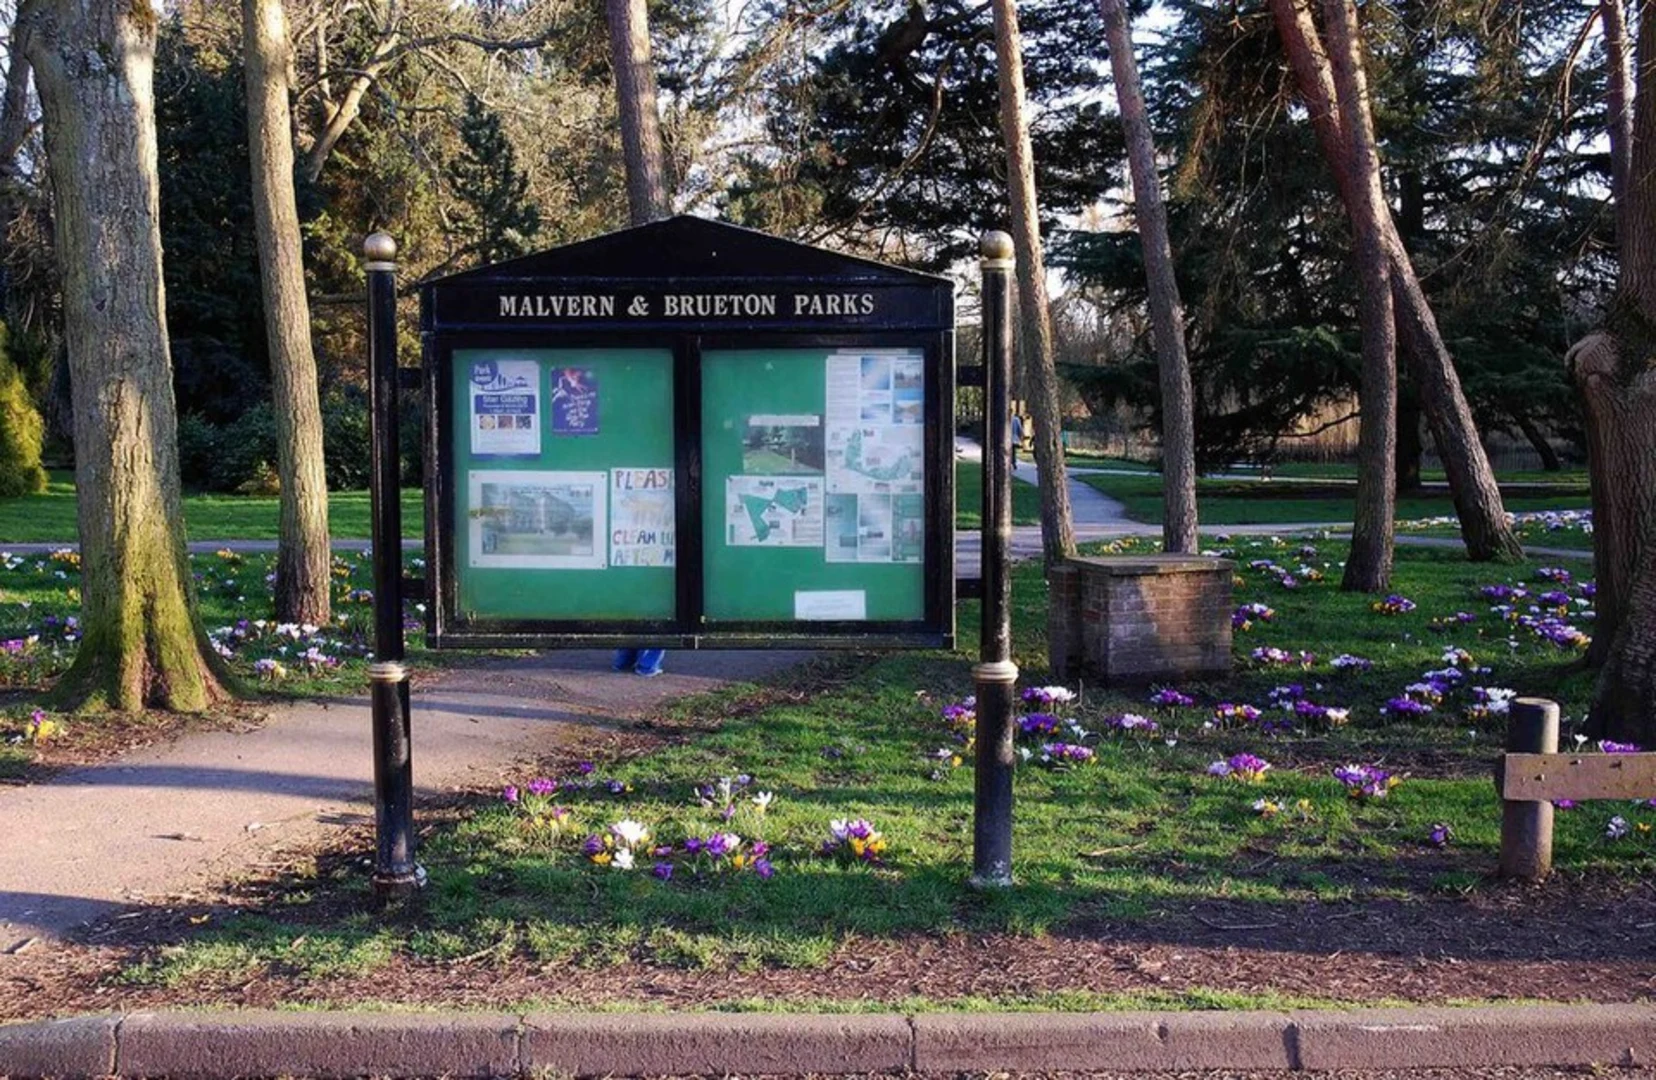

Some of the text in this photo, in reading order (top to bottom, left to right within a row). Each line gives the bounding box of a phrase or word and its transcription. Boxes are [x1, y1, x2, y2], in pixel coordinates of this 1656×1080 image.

[499, 294, 874, 316] MALVERN & BRUETON PARKS
